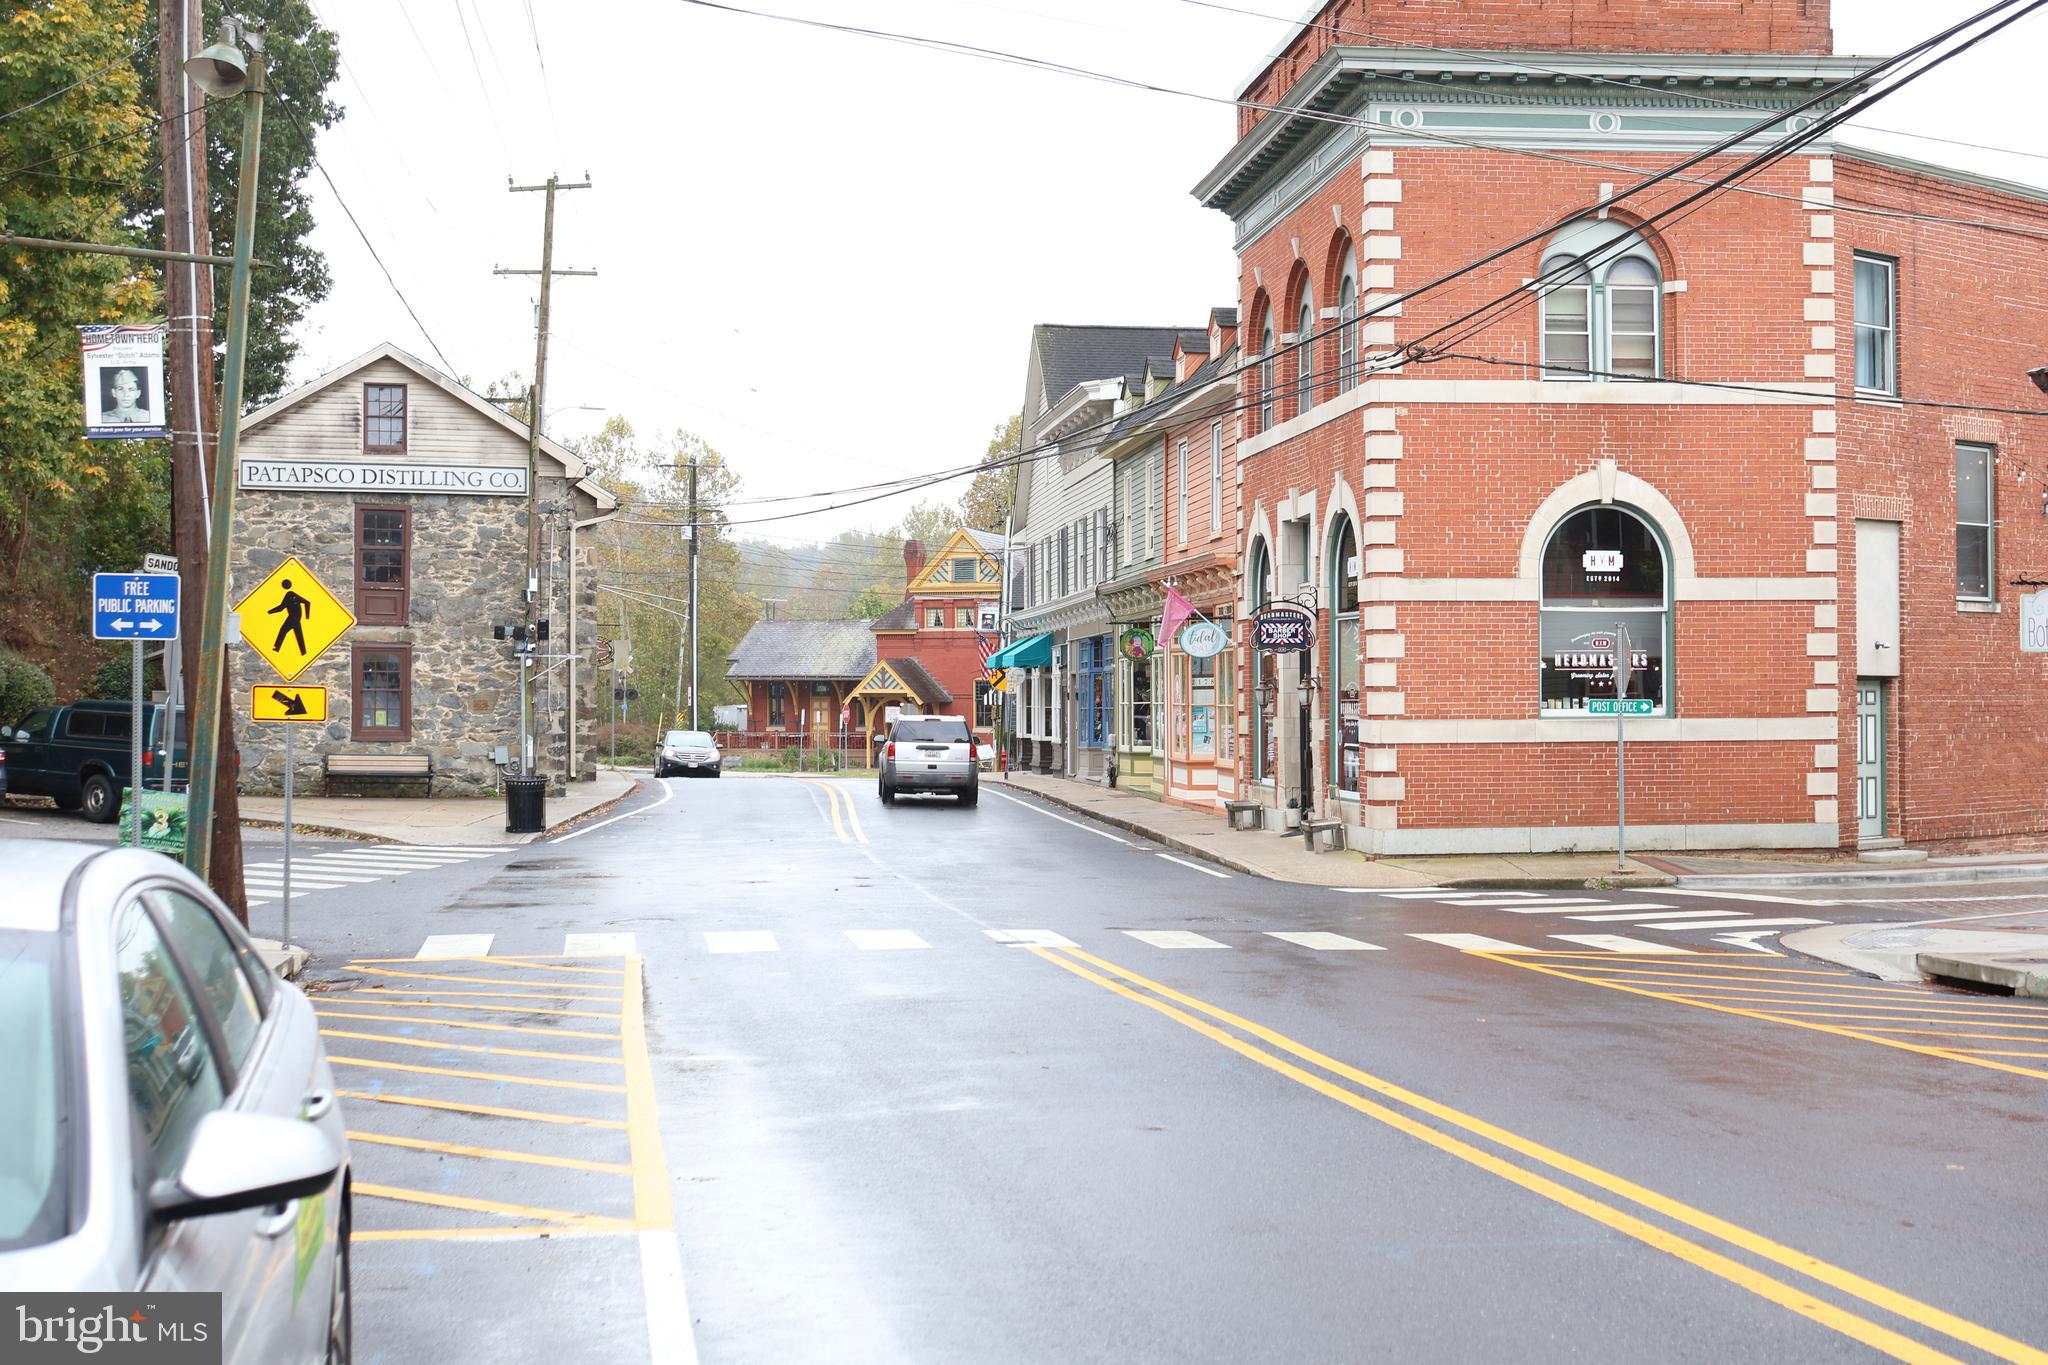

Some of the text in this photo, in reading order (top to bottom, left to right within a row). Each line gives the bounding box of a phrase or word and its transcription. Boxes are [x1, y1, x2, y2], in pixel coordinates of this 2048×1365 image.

[86, 333, 159, 344] HOMETOWN HERO
[247, 464, 523, 489] PATAPSCO DISTILLING CO.
[124, 581, 150, 596] FREE
[98, 598, 175, 614] PUBLIC PARKING
[1554, 653, 1648, 667] HEADMASRS
[1592, 701, 1638, 712] POST OFFICE
